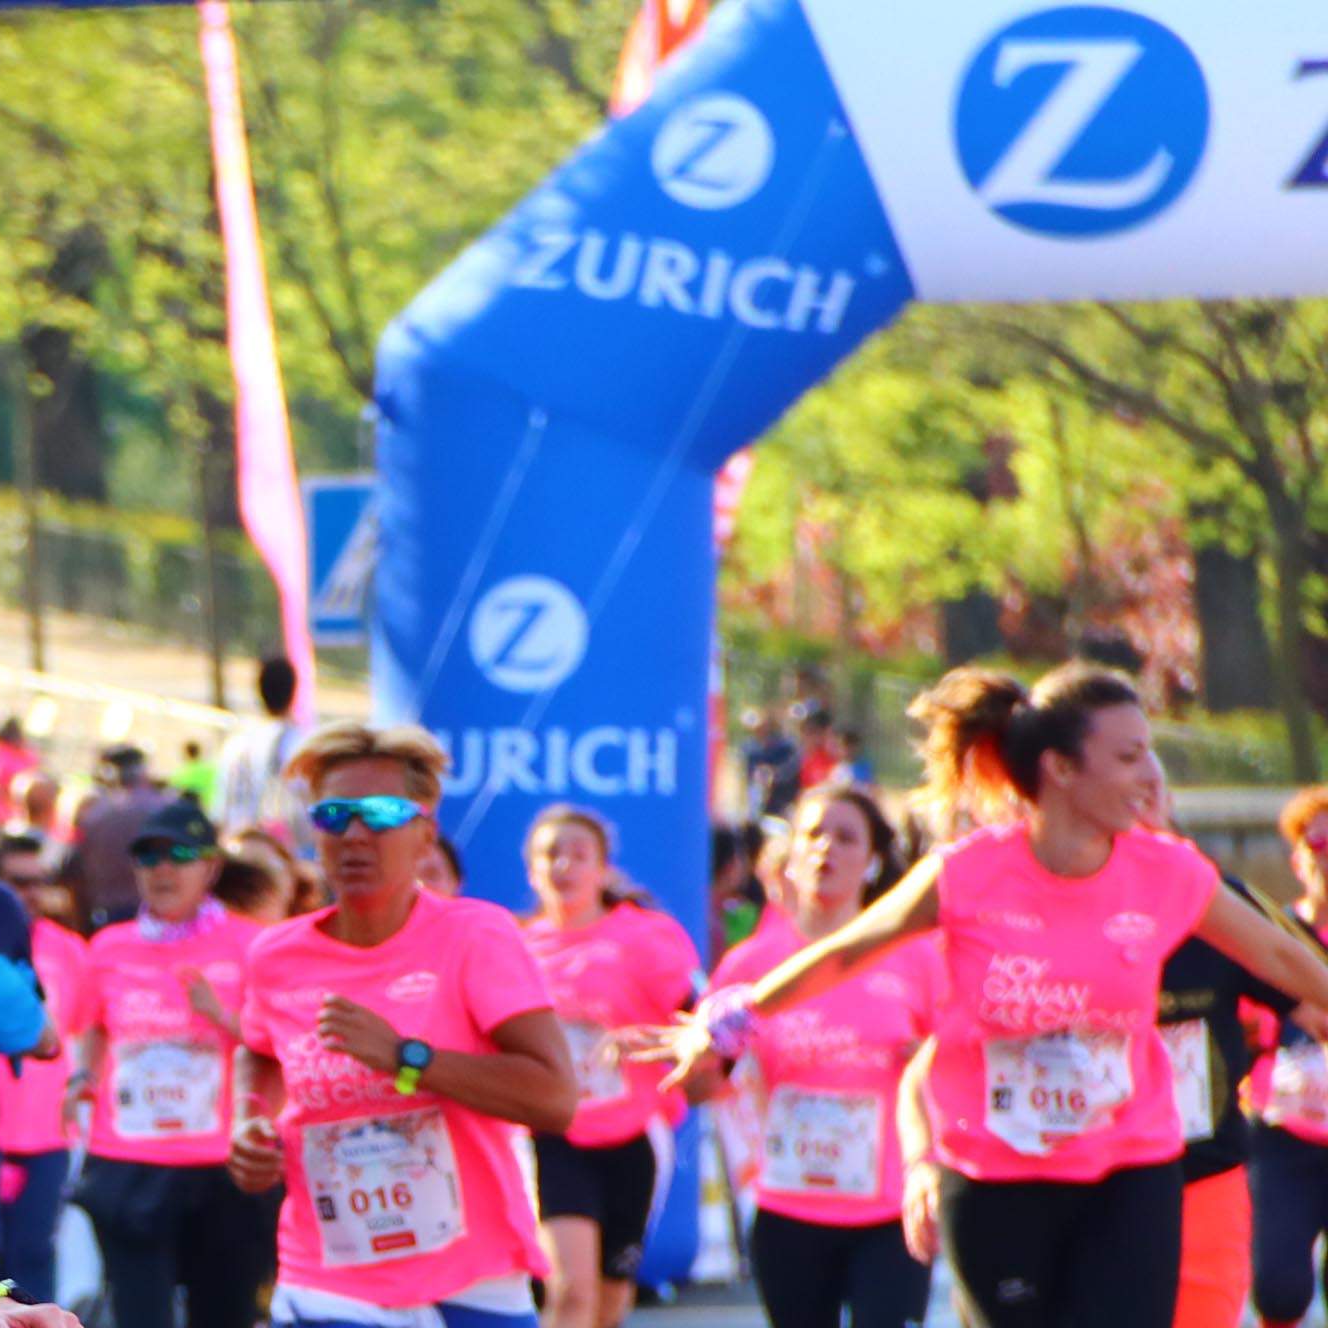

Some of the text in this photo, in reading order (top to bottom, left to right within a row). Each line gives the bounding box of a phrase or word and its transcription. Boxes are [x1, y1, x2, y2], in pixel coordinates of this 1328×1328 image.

[509, 226, 857, 334] ZURICH
[434, 725, 678, 797] URICH
[1030, 1087, 1087, 1113] 016
[350, 1182, 413, 1215] 016
